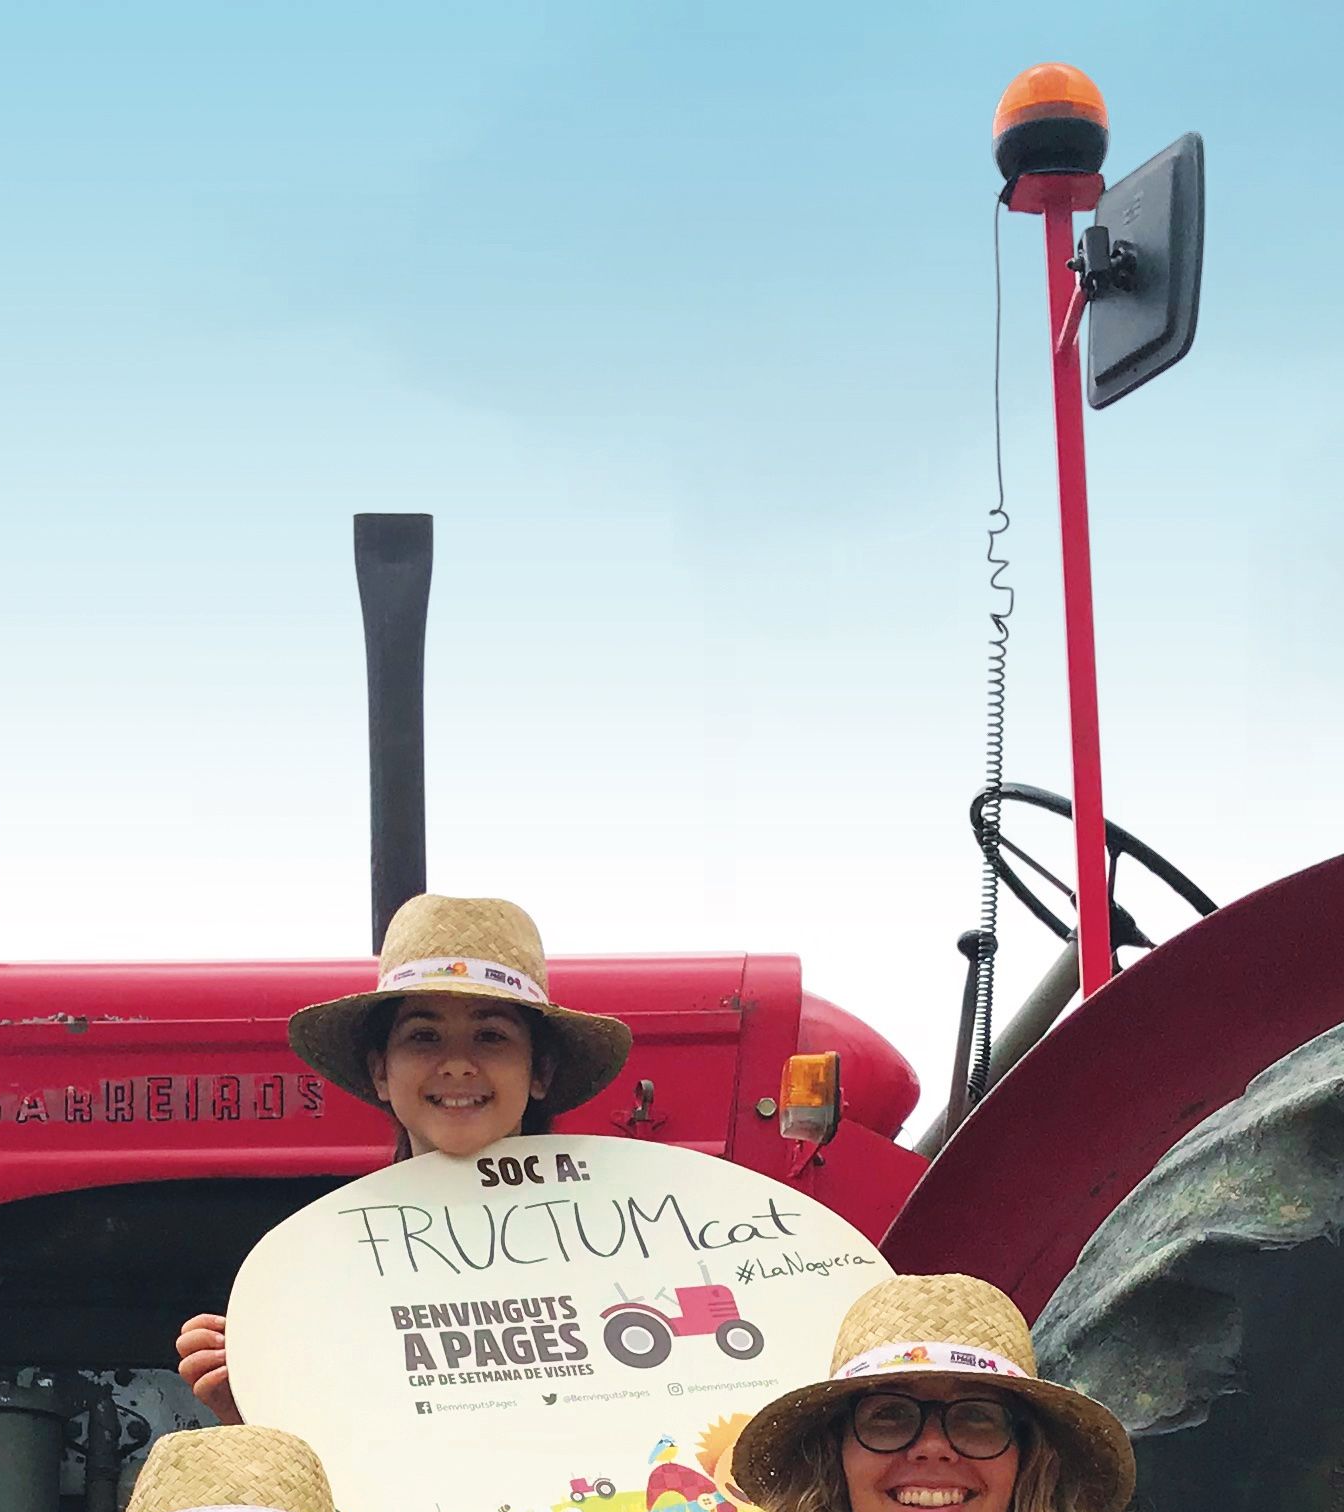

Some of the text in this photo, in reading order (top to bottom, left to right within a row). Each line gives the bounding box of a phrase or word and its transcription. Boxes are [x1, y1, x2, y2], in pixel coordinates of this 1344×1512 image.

[477, 1153, 591, 1188] SOC A:
[735, 1252, 876, 1285] #LaNoguera
[390, 1295, 578, 1330] BENVINGUTS
[404, 1319, 589, 1372] A PAGÈS
[408, 1363, 595, 1387] CAP DE SETMANA DE VISITES
